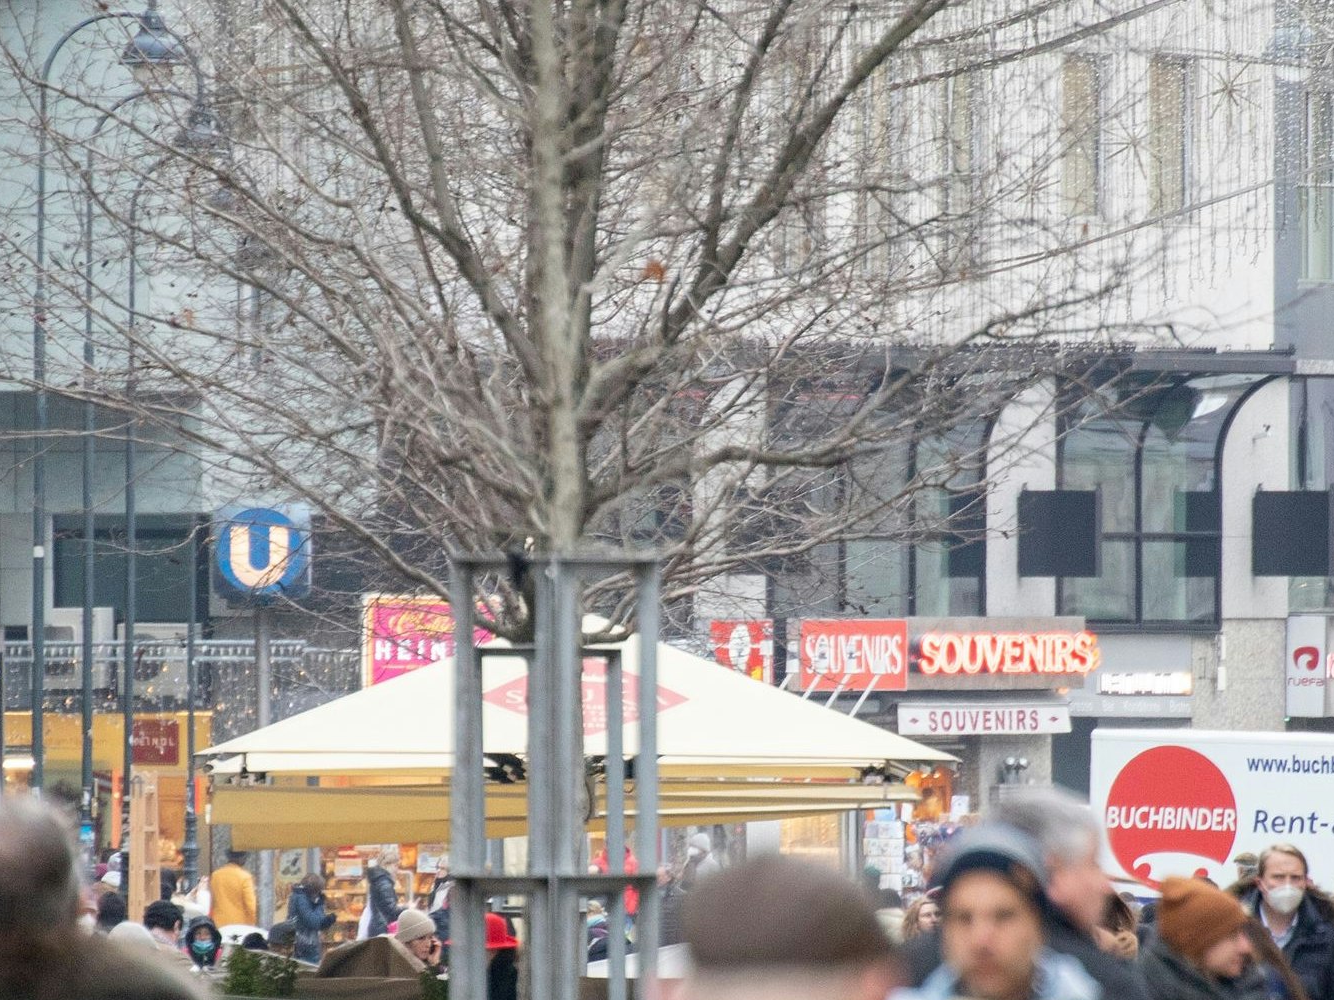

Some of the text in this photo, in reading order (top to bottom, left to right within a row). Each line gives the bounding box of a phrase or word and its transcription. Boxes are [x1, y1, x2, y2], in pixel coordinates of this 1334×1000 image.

[805, 631, 1099, 675] SOUVENIRS SOUVENIRS
[929, 709, 1039, 732] SOUVENIRS
[1106, 805, 1238, 832] BUCHBINDER
